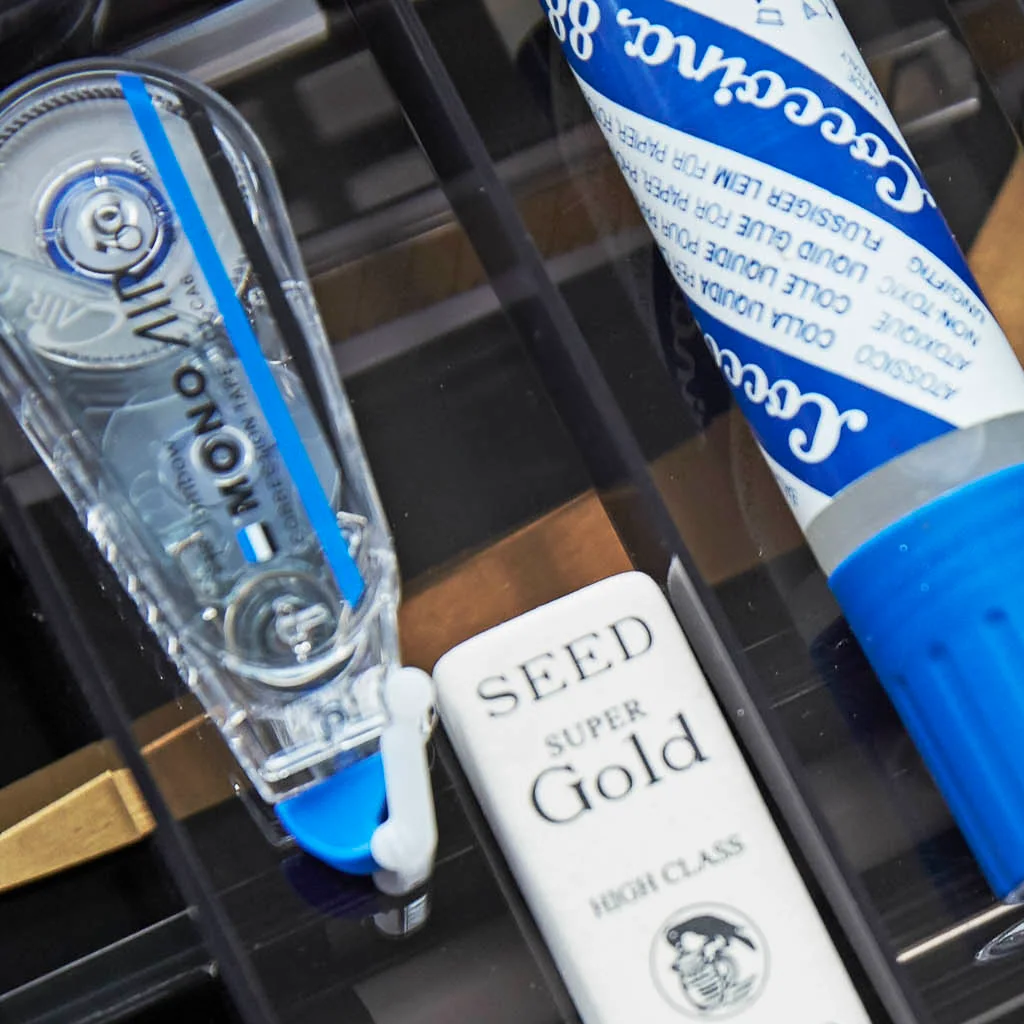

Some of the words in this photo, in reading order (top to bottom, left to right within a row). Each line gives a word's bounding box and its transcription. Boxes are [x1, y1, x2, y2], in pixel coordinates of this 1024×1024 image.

[616, 8, 937, 213] Coccoina
[712, 164, 763, 199] LEIM
[661, 222, 699, 254] POUR
[695, 203, 731, 229] FOR
[736, 214, 792, 251] GLUE
[705, 240, 778, 287] LIQUIDE
[797, 239, 869, 284] LIQUID
[700, 276, 765, 322] LIQUIDA
[782, 272, 851, 314] COLLE
[907, 256, 986, 324] UNGIFTIG
[771, 310, 836, 349] COLLA
[872, 311, 971, 371] ATOXIQUE
[854, 344, 958, 400] ATOSSICO
[173, 365, 259, 517] MONO
[476, 615, 654, 718] SEED
[544, 698, 648, 757] SUPER
[530, 711, 709, 824] Gold
[589, 872, 658, 918] HIGH
[661, 834, 746, 885] CLASS
